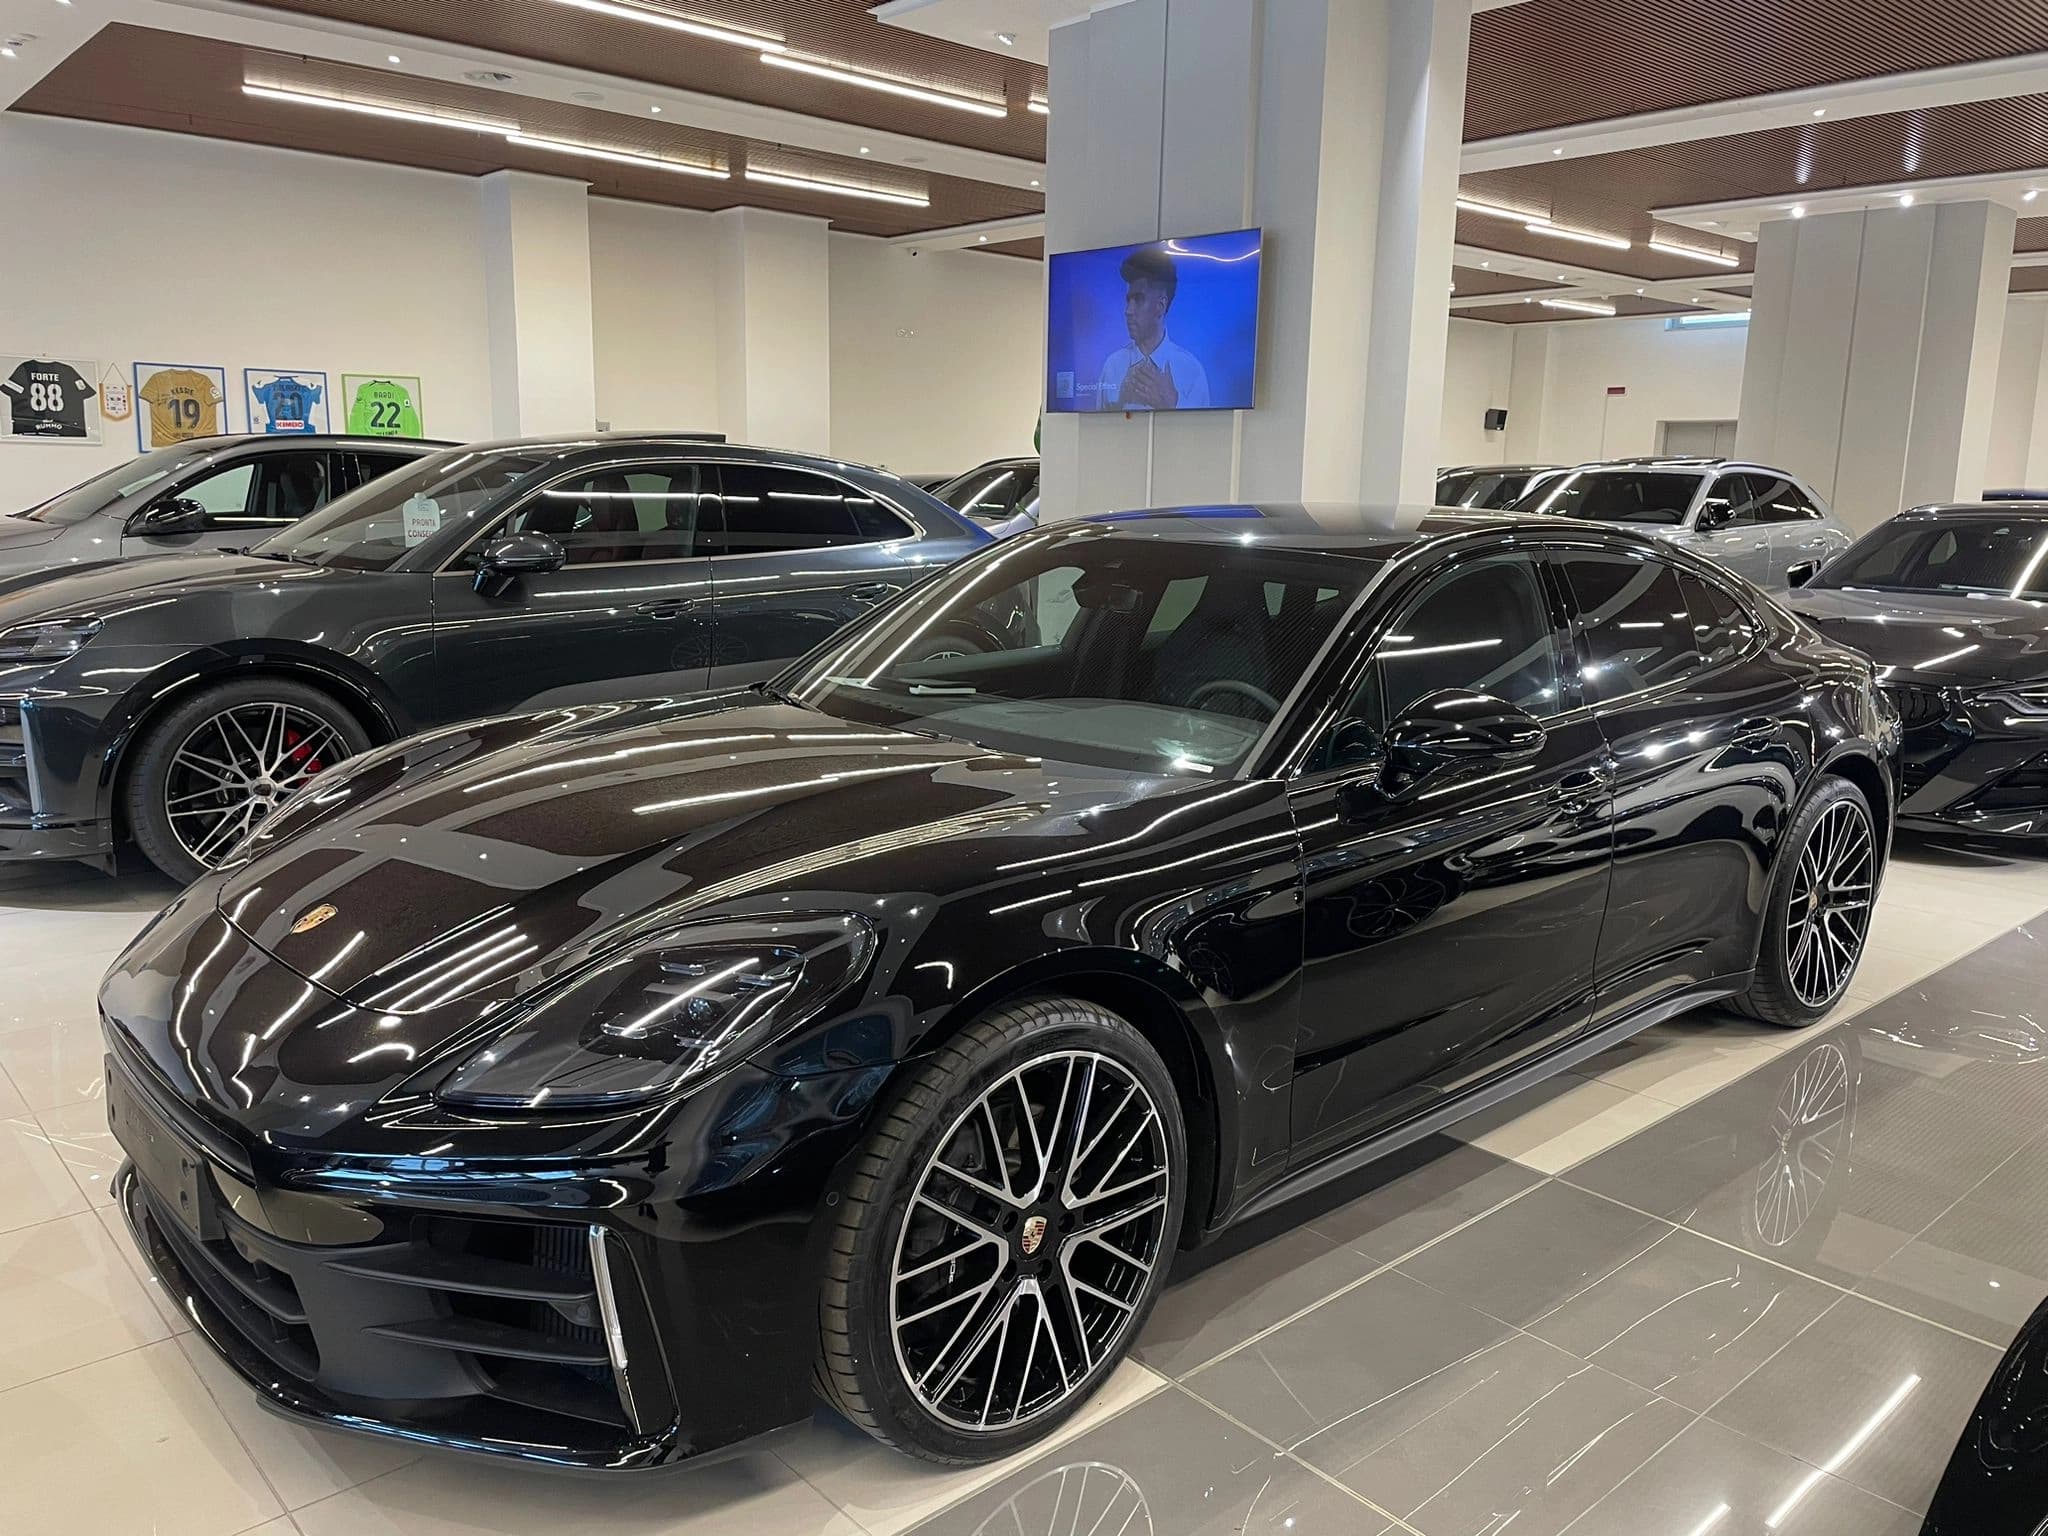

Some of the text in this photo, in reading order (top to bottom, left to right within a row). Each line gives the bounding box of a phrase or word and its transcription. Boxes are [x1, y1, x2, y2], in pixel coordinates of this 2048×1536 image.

[31, 372, 60, 382] FORTE
[30, 382, 65, 412] 88
[167, 398, 201, 429] 19
[370, 401, 401, 428] 22
